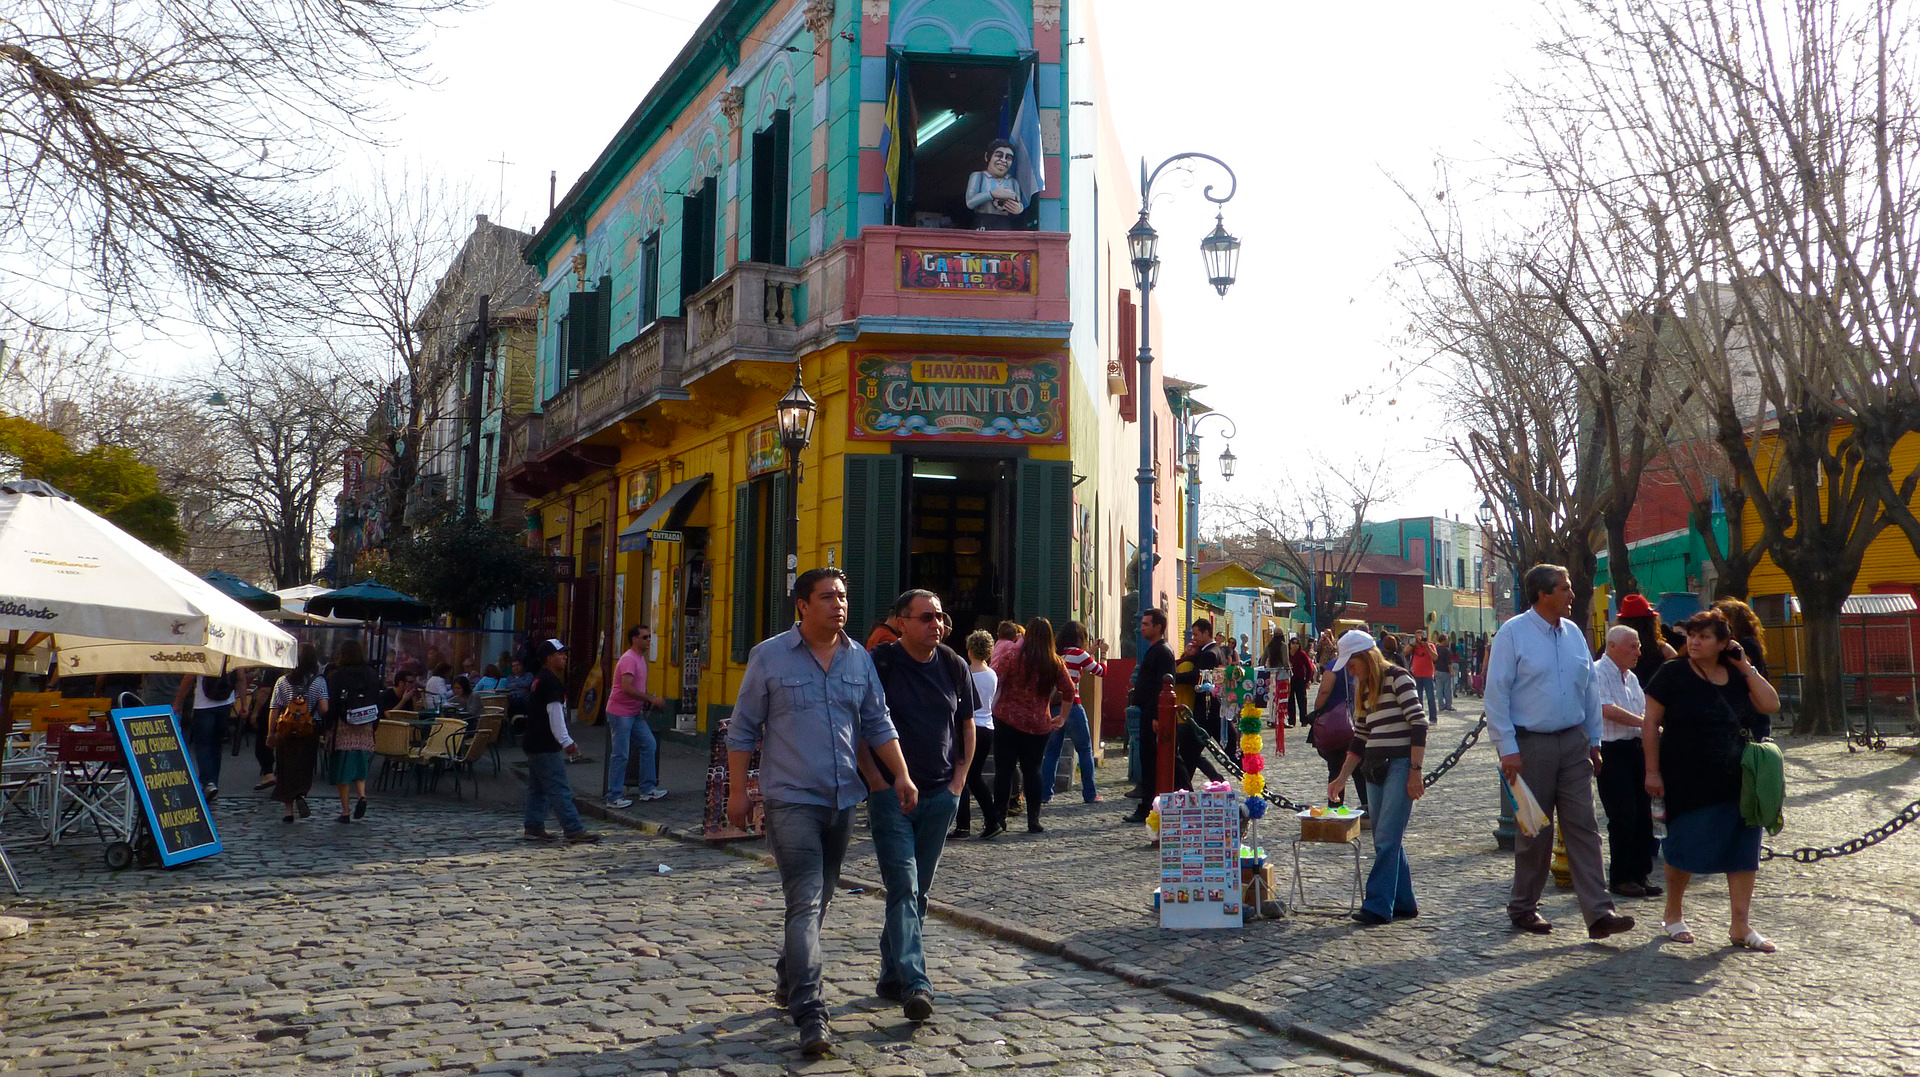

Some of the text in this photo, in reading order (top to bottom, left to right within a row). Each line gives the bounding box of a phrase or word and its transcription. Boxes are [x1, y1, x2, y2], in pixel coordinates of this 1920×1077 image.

[940, 272, 995, 283] AMIGO
[921, 364, 1001, 379] HAVANNA
[884, 380, 1034, 415] CAMINITO
[937, 416, 965, 428] DESDE
[653, 531, 680, 541] ENTRADA
[130, 719, 169, 737] CHOCOLATE
[132, 736, 178, 755] CON CHURROS
[149, 757, 157, 770] $
[162, 793, 170, 807] $
[159, 807, 200, 829] MILKSHAKE
[174, 830, 182, 844] $
